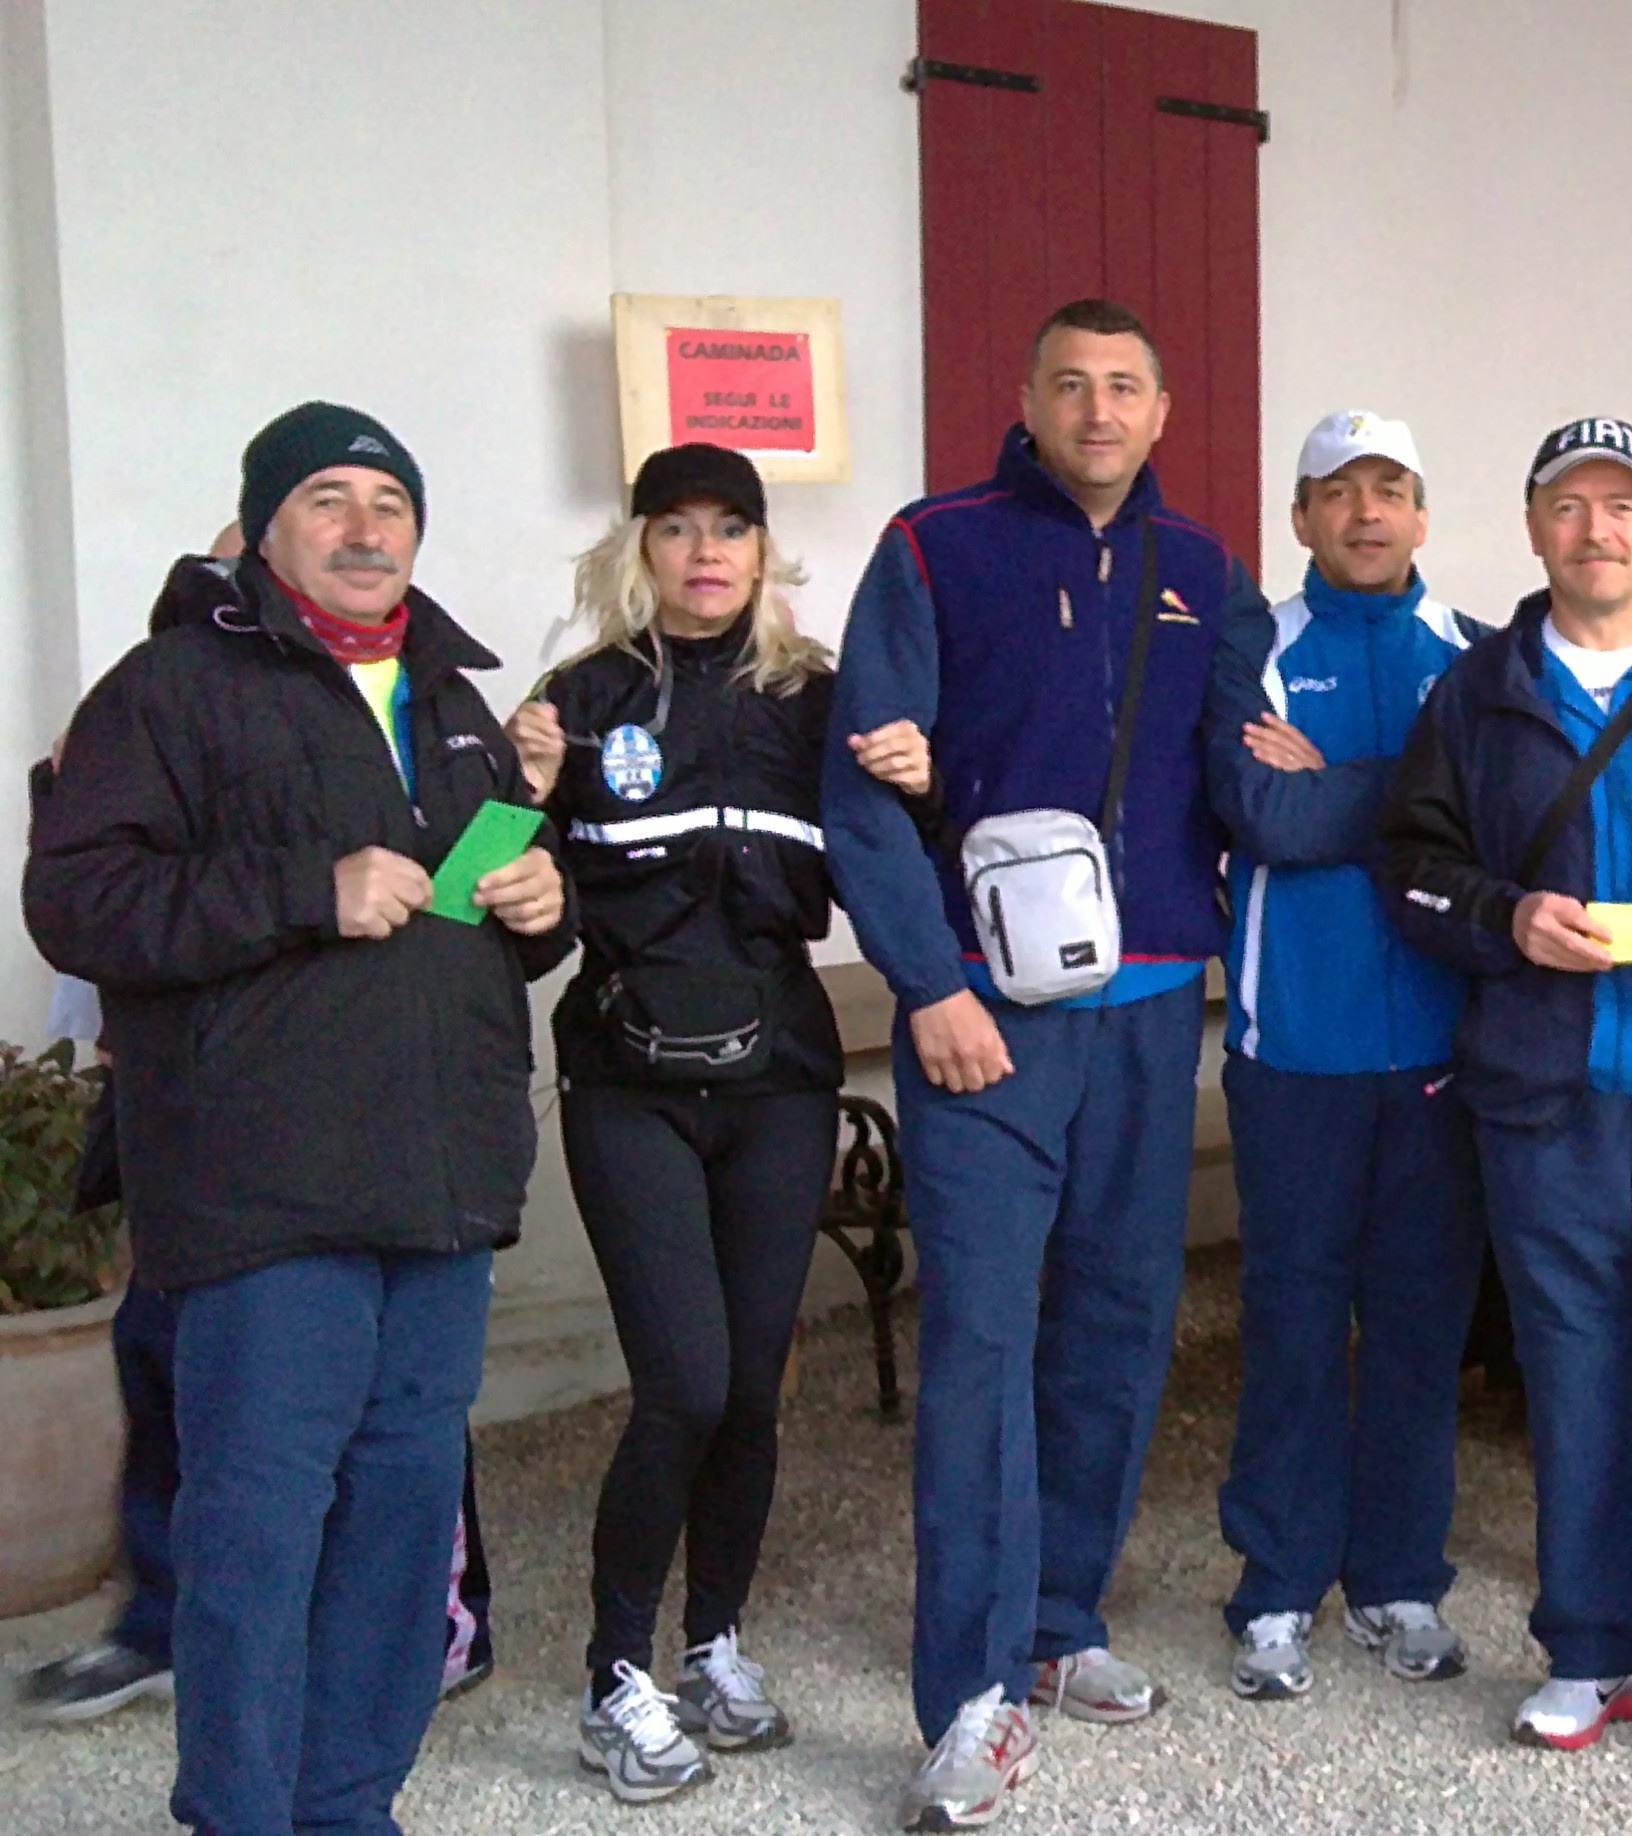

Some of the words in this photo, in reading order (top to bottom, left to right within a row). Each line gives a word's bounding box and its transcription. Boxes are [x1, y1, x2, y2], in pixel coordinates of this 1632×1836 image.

[679, 342, 800, 361] CAMINADA
[704, 392, 757, 407] SEGUI
[769, 394, 790, 408] LE
[686, 415, 802, 430] INDICAZIONI
